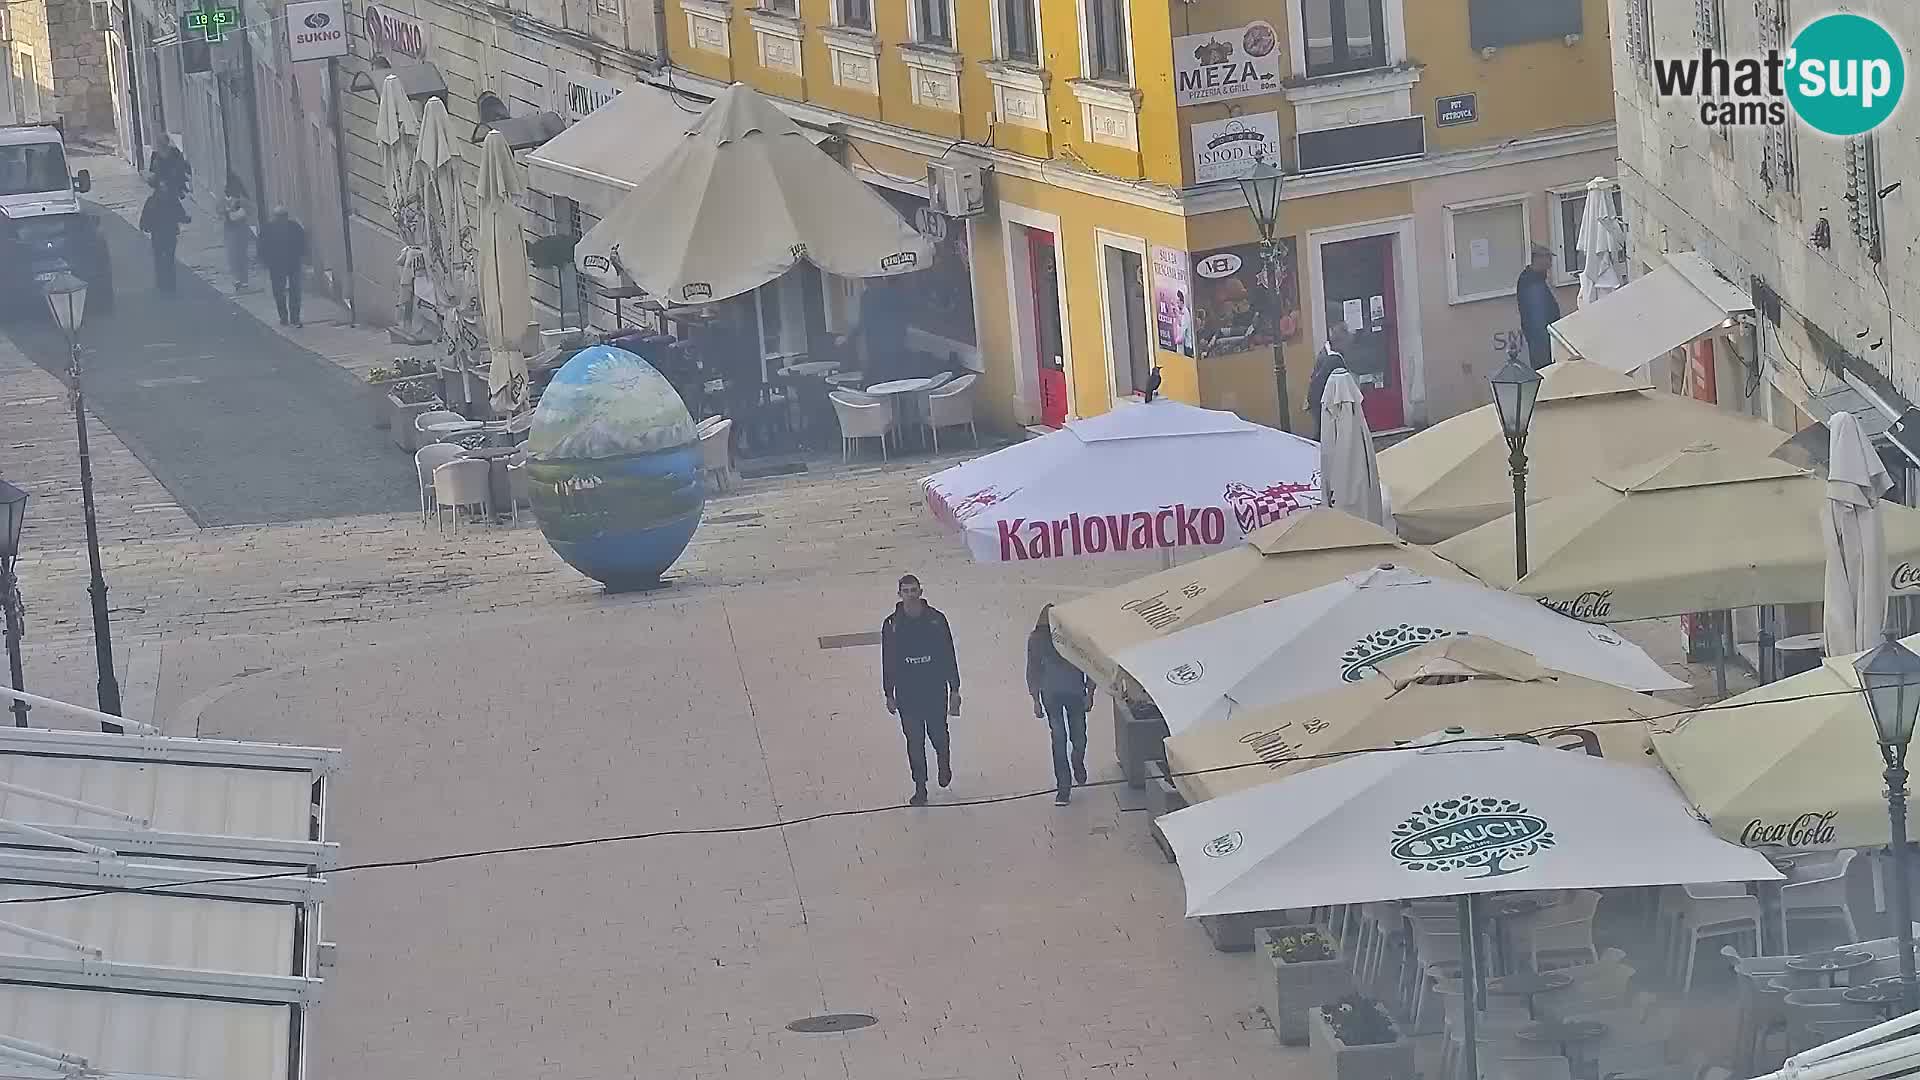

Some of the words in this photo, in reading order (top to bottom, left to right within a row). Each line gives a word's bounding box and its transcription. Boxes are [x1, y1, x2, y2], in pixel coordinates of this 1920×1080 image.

[296, 30, 341, 45] SUKNO
[383, 14, 422, 55] SUKNO
[1180, 61, 1258, 92] MEZA
[1189, 88, 1221, 99] PIZZERIA
[1199, 147, 1243, 165] ISPOD
[998, 503, 1225, 561] Karlovačko
[1431, 819, 1530, 851] RAUCH
[1741, 811, 1839, 848] Coca-Cola
